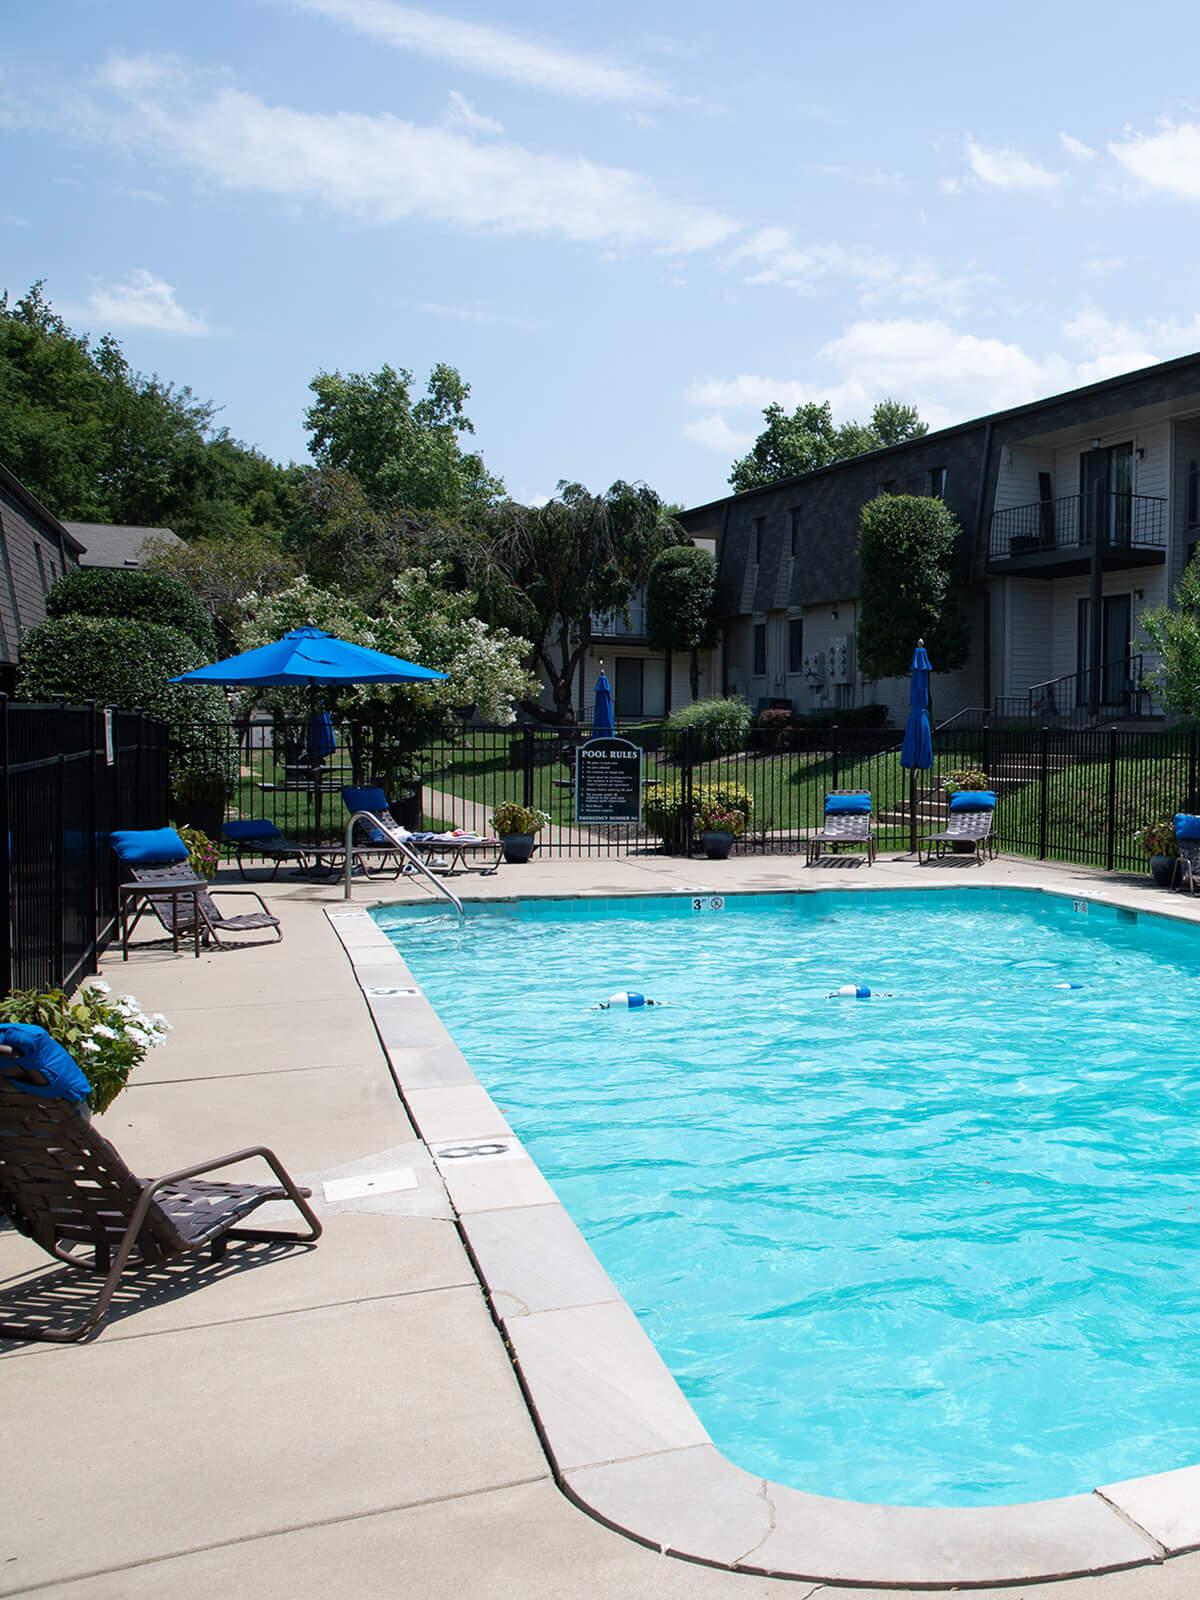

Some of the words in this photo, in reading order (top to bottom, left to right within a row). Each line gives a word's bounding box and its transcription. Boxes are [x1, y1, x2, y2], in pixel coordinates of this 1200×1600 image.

[581, 750, 608, 758] POOL
[610, 751, 638, 759] RULES
[693, 899, 702, 910] 3
